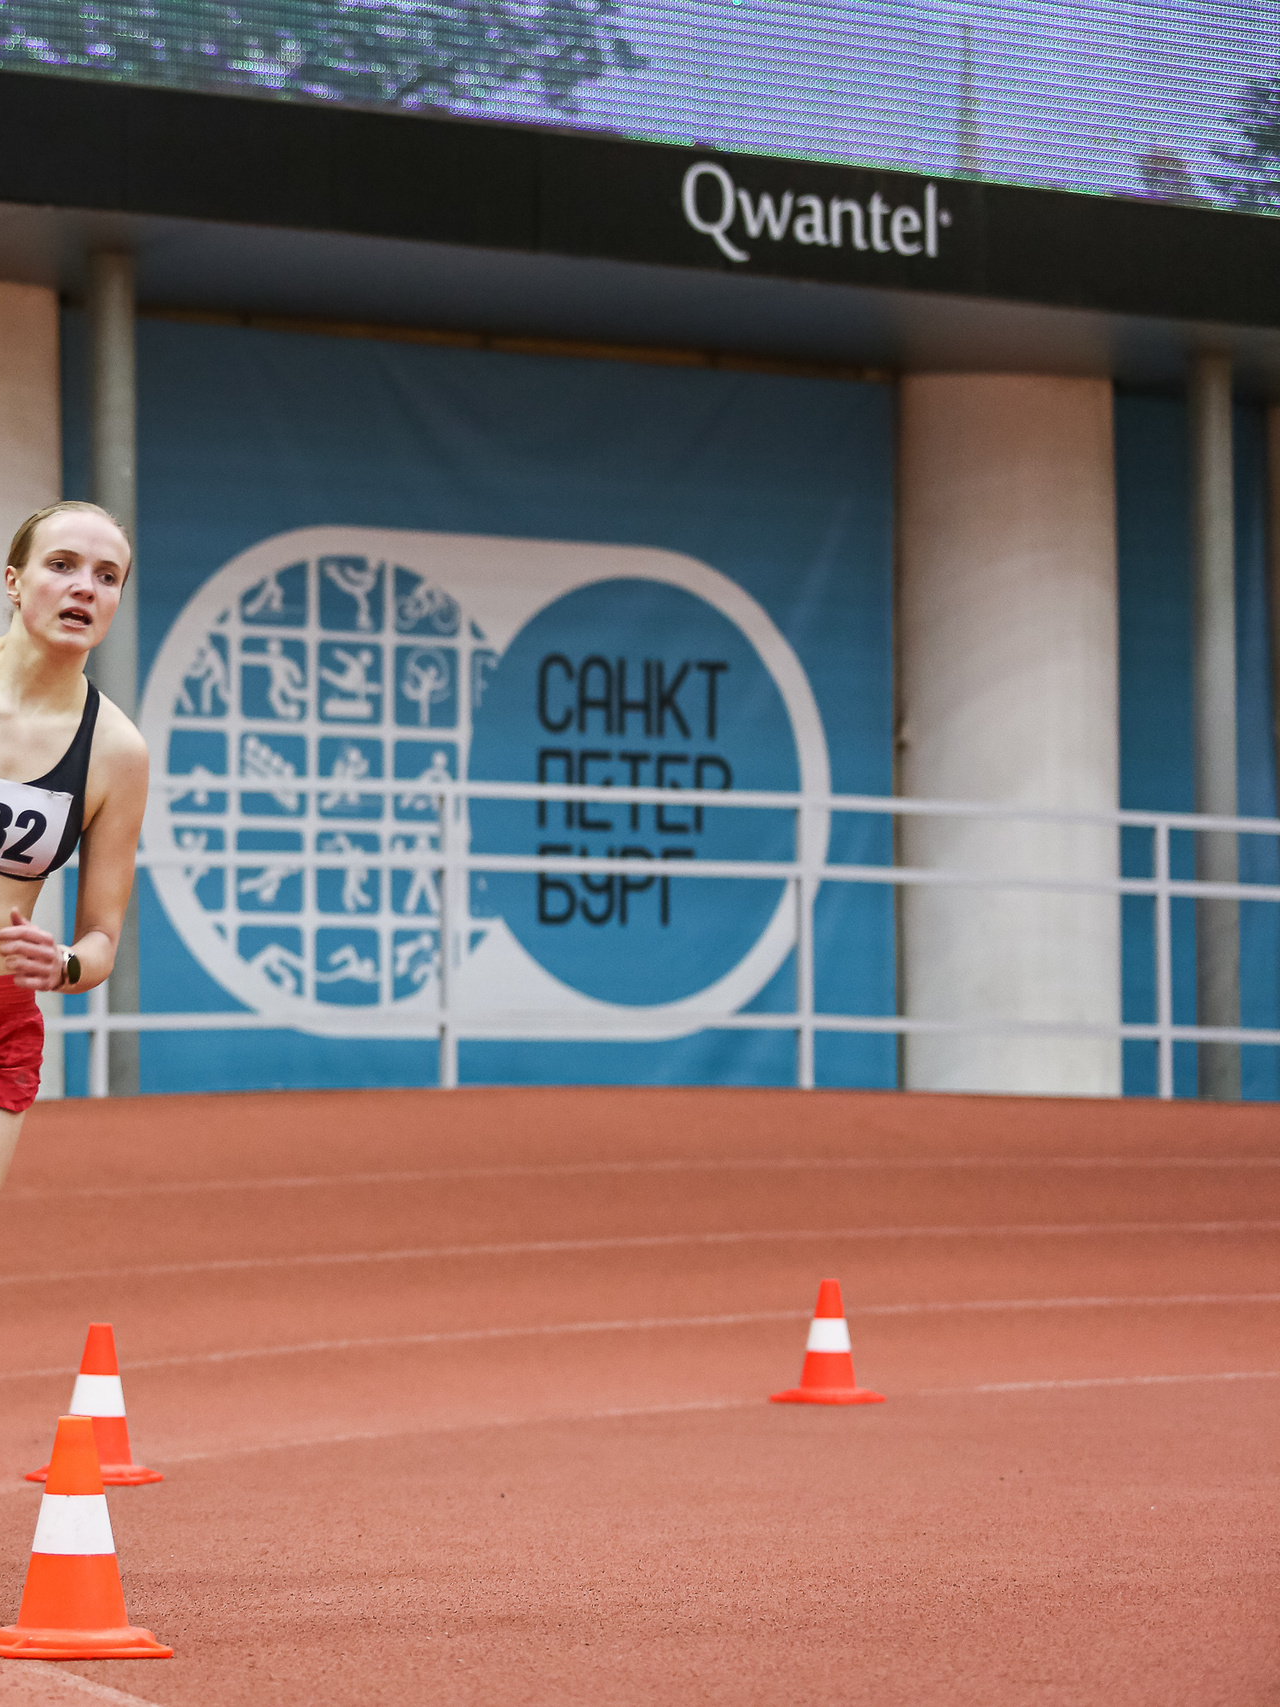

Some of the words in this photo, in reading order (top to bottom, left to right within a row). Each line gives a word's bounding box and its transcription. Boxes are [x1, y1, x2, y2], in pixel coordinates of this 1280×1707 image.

[681, 161, 939, 263] Qwantel
[537, 652, 730, 741] САНКТ
[537, 747, 733, 834] ПЕТЕР
[537, 843, 696, 927] БУРГ
